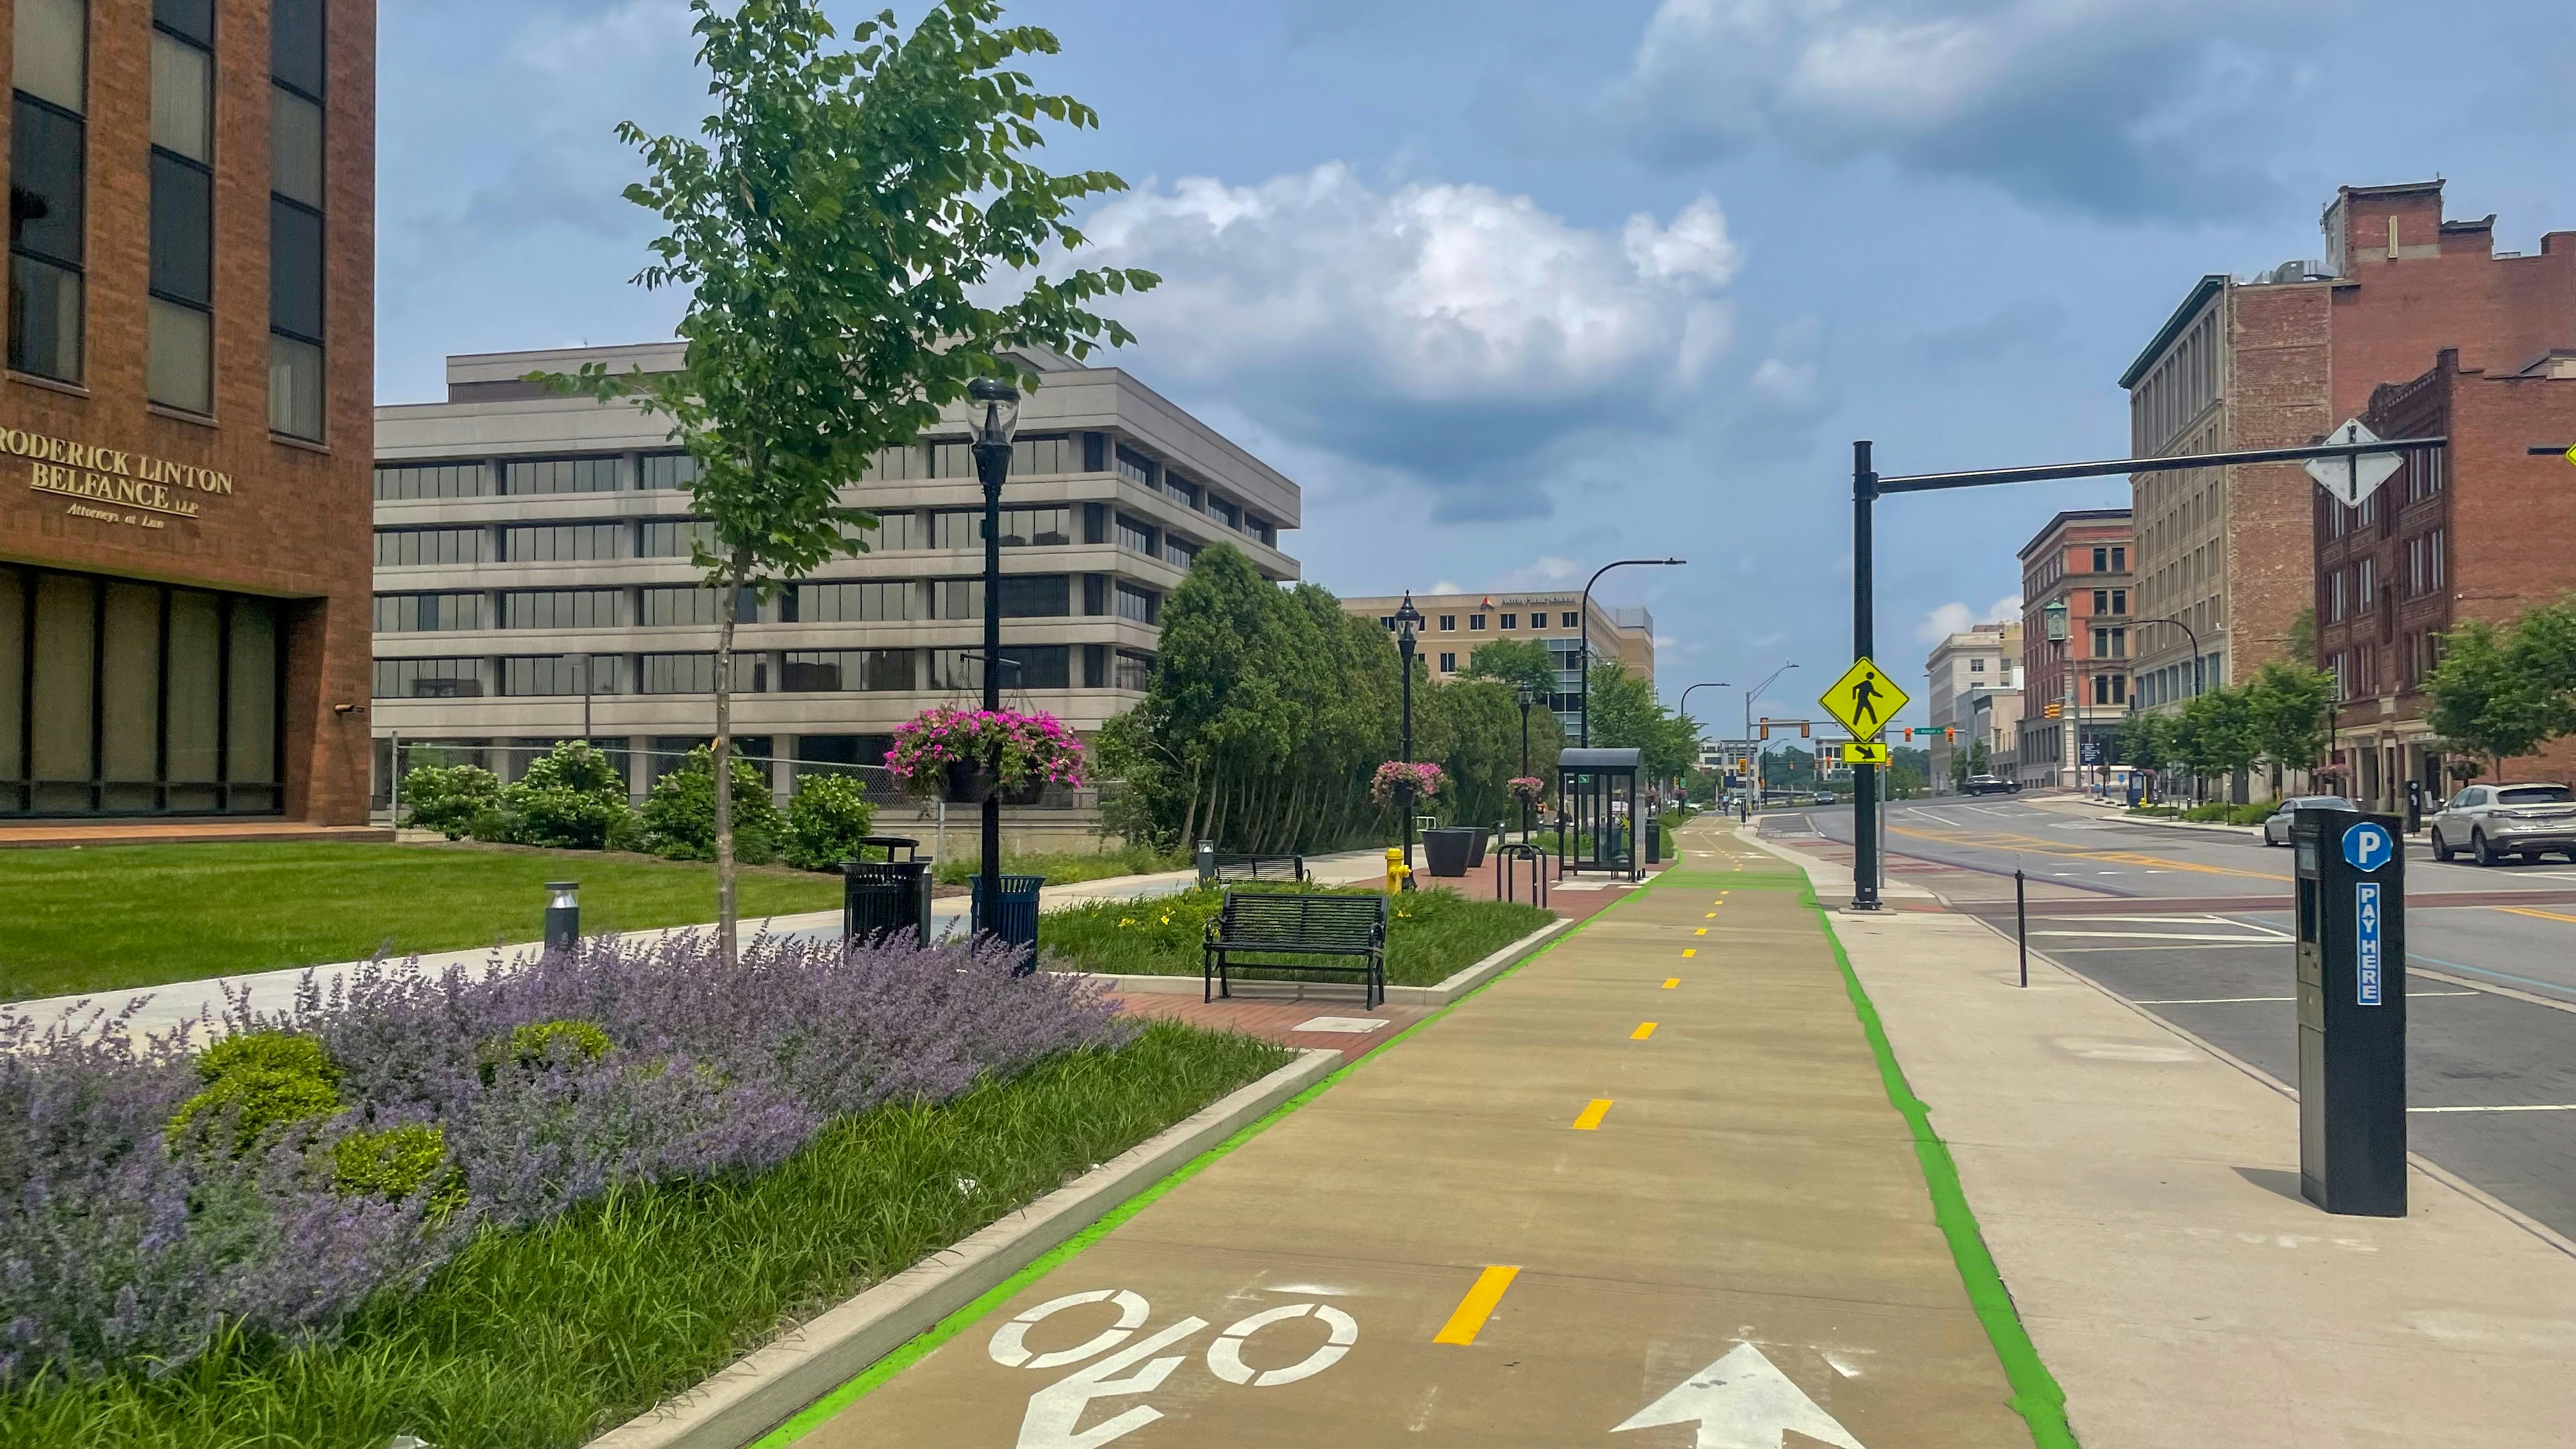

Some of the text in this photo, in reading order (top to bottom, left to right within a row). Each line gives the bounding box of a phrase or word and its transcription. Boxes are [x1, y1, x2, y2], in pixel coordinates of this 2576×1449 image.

[31, 462, 170, 509] BELFANCE
[139, 456, 233, 494] LINTON
[67, 502, 119, 523] Attorneys
[2358, 831, 2380, 864] P
[2361, 887, 2377, 999] PAY HERE
